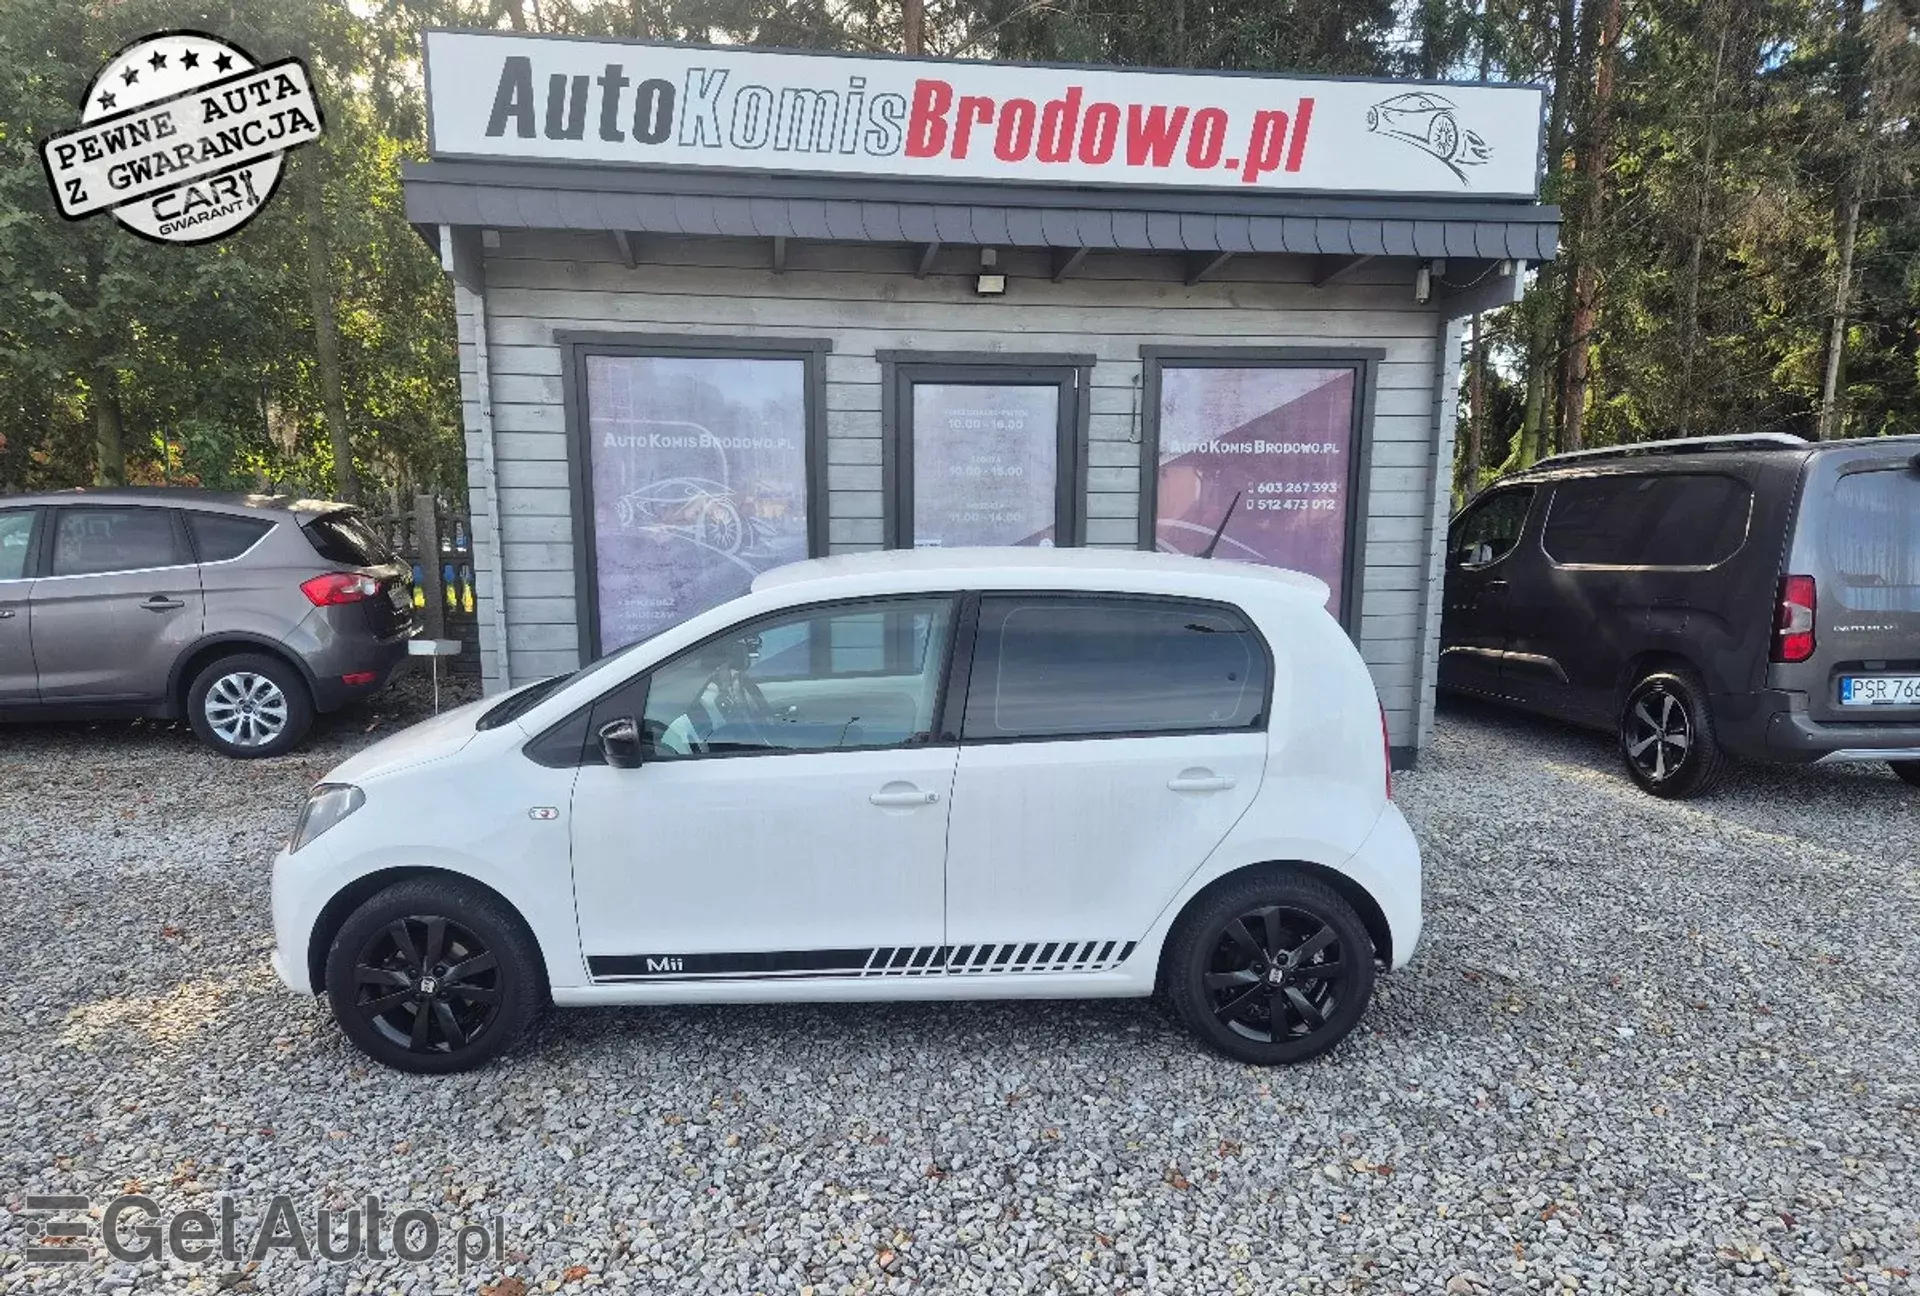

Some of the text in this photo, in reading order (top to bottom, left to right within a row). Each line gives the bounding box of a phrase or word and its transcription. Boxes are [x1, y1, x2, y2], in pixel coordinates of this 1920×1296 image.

[485, 55, 1315, 183] AutoKomisBrodowo.pl
[1257, 482, 1338, 493] 603 267 393
[1257, 499, 1336, 510] 512 473 012
[1852, 680, 1887, 698] PSR
[646, 957, 683, 972] Mii
